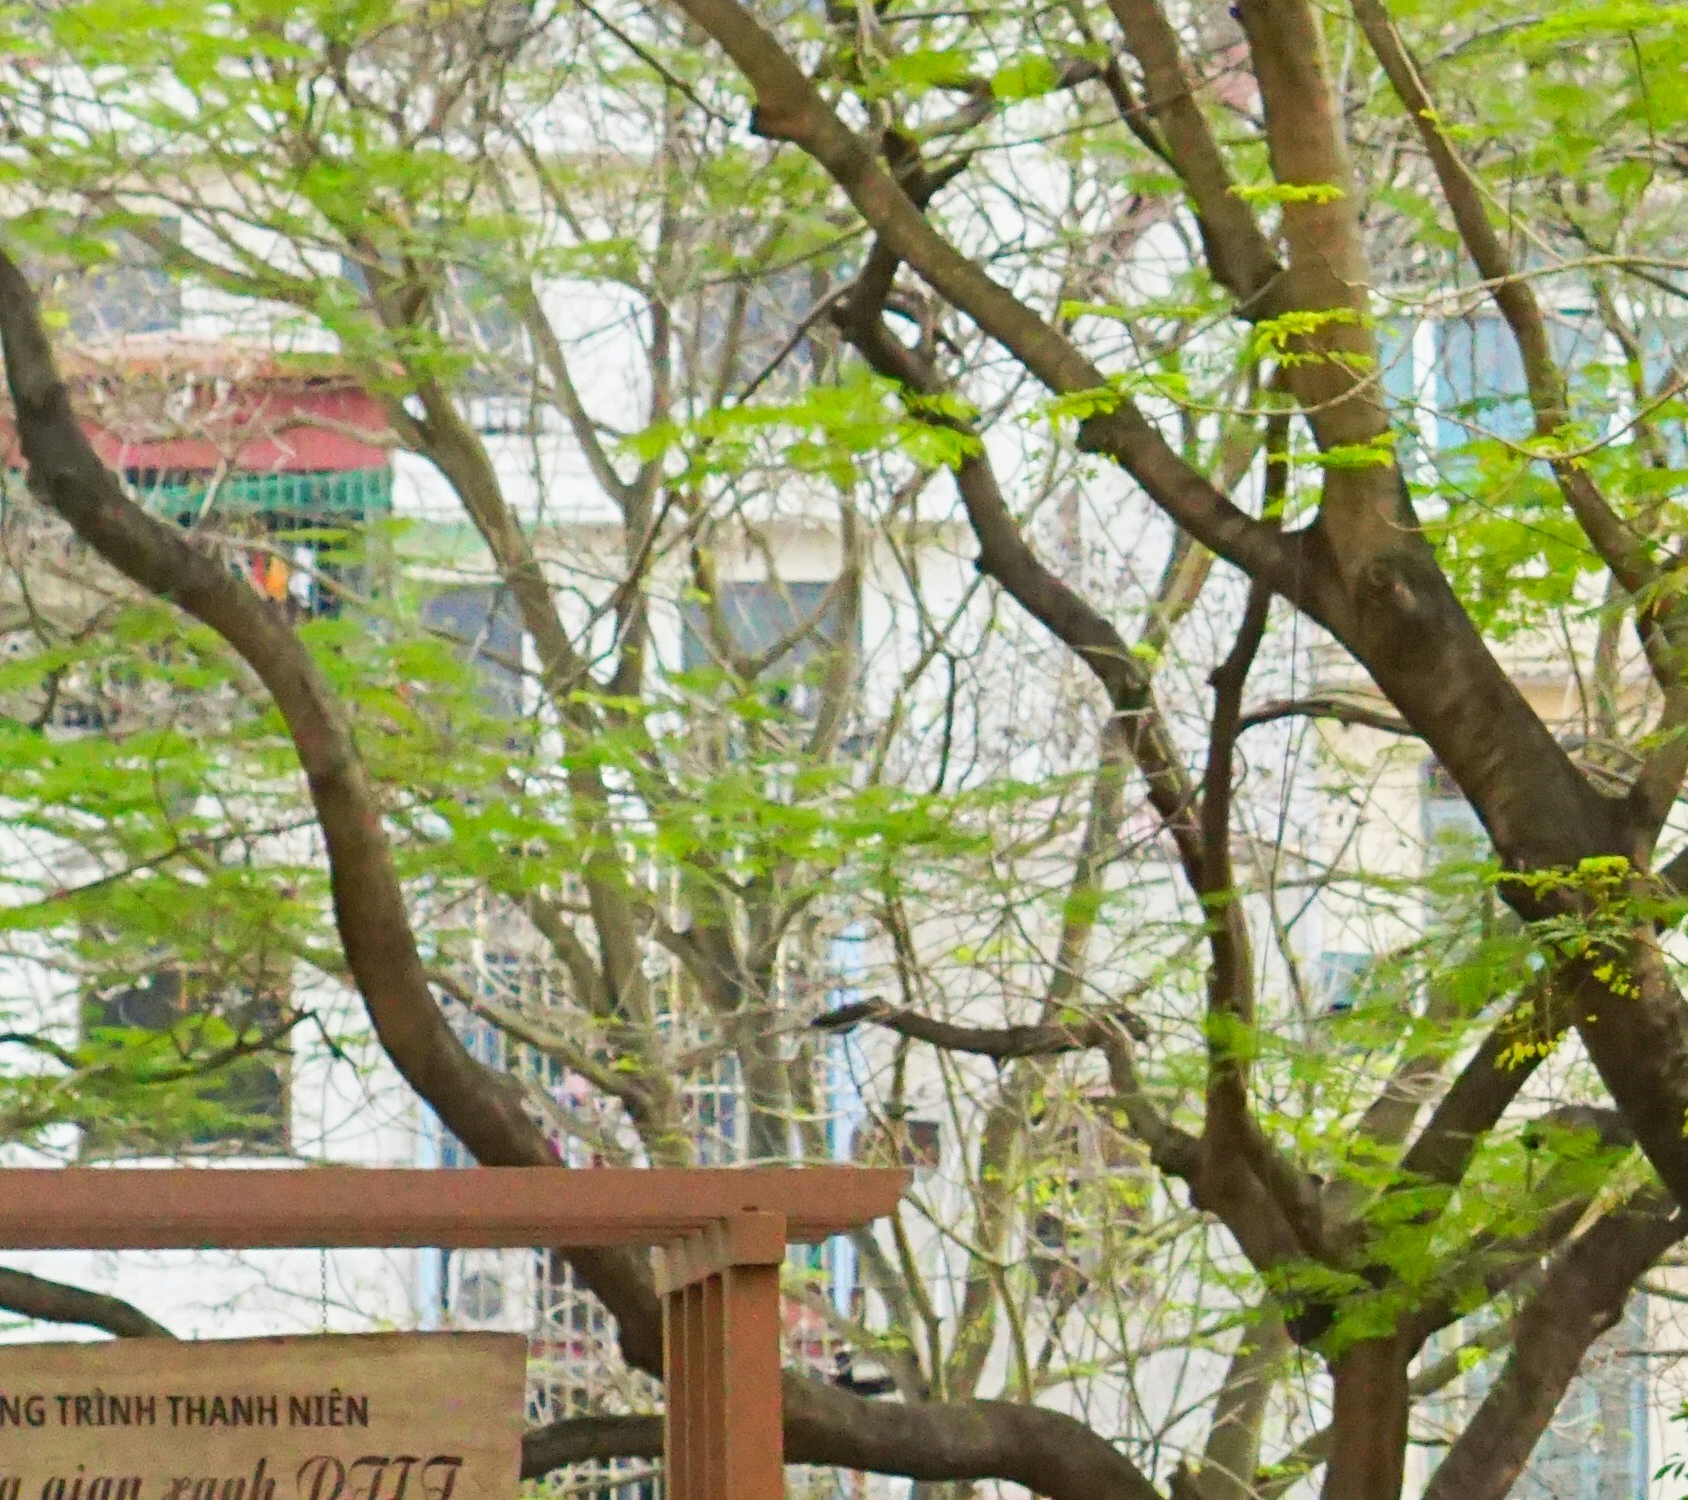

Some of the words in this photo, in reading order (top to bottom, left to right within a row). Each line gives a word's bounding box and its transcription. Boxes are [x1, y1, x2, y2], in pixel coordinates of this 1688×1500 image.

[55, 1387, 156, 1428] TRÌNH
[167, 1395, 278, 1428] THANH
[289, 1387, 369, 1428] NIÊN
